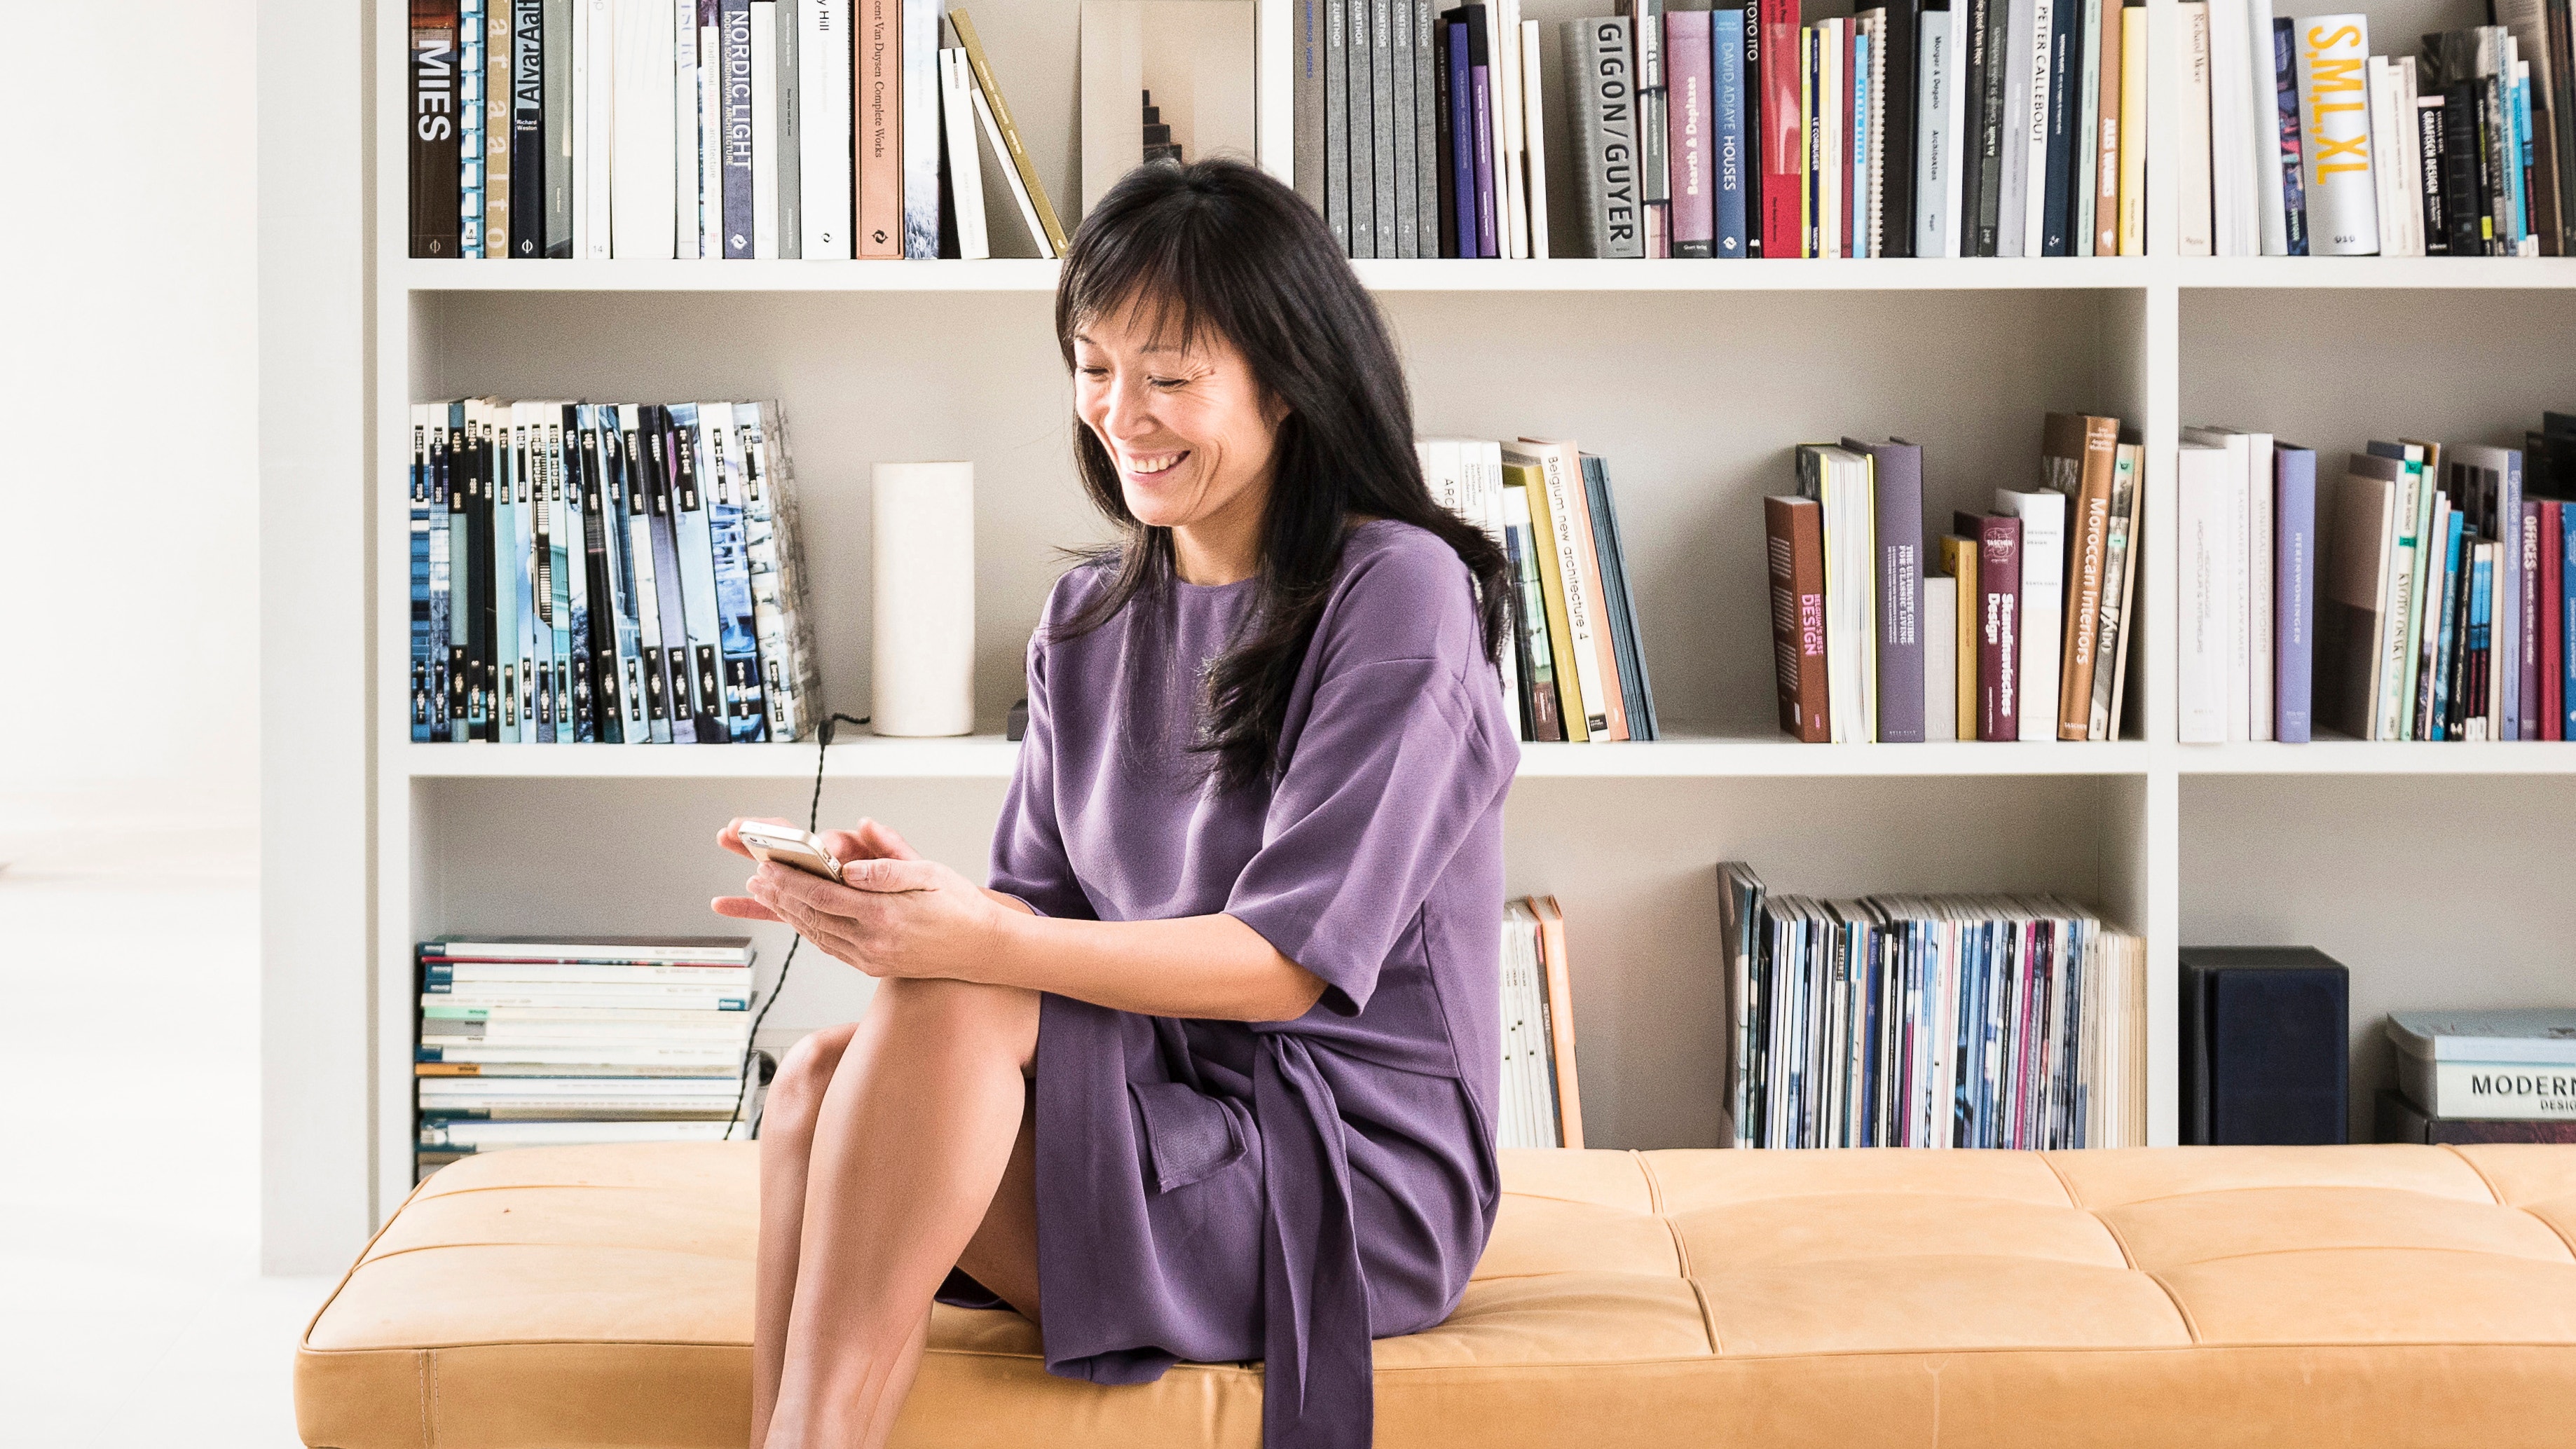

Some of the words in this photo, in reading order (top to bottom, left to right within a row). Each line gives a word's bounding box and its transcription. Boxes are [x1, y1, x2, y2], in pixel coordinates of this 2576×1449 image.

[723, 11, 732, 45] MODERN
[818, 11, 830, 32] Hill
[875, 22, 885, 41] Van
[1355, 1, 1363, 45] ZUMTHOR
[1378, 3, 1386, 47] ZUMTHOR
[1398, 3, 1406, 46] ZUMTHOR
[1420, 3, 1429, 47] ZUMTHOR
[1746, 1, 1758, 37] TOYO
[2036, 7, 2048, 50] PETER
[2193, 13, 2205, 54] Richard
[707, 42, 717, 86] traditional
[731, 11, 750, 97] NORDIC
[872, 43, 885, 78] Duysen
[1722, 42, 1735, 82] DAVID
[1747, 39, 1758, 62] ITO
[418, 40, 451, 141] MIES
[724, 47, 734, 104] SCANDINAVIAN
[706, 88, 717, 127] Japanese
[872, 81, 886, 127] Complete
[1685, 77, 1698, 136] Deplazes
[1813, 117, 1819, 126] LE
[2032, 55, 2046, 144] CALLEBOUT
[2303, 25, 2369, 185] S,M,L,XL
[708, 128, 718, 179] architecture
[725, 107, 734, 165] ARCHITECTURE
[732, 104, 752, 171] LIGHT
[874, 129, 886, 158] Works
[1598, 24, 1633, 242] GIGON/GUYER
[1687, 140, 1698, 149] &
[1986, 146, 1996, 156] As
[1686, 151, 1699, 195] Bearth
[1724, 135, 1736, 191] HOUSES
[2425, 158, 2438, 194] DESIGN
[593, 245, 603, 254] 14
[1359, 224, 1366, 232] 4
[1404, 225, 1410, 233] 2
[1547, 457, 1564, 511] Belgium
[1558, 516, 1570, 542] new
[2083, 498, 2106, 586] Moroccan
[2523, 516, 2537, 570] OFFICES
[1563, 547, 1587, 628] architecture
[1906, 566, 1914, 613] ULTIMATE
[2293, 533, 2303, 644] HERENWONINGEN
[1802, 594, 1817, 657] DESIGN
[1814, 594, 1823, 634] BELGIUM'S
[1907, 614, 1915, 645] GUIDE
[1986, 593, 2001, 644] Design
[2076, 590, 2098, 664] Interiors
[2001, 593, 2014, 717] Skandinavisches
